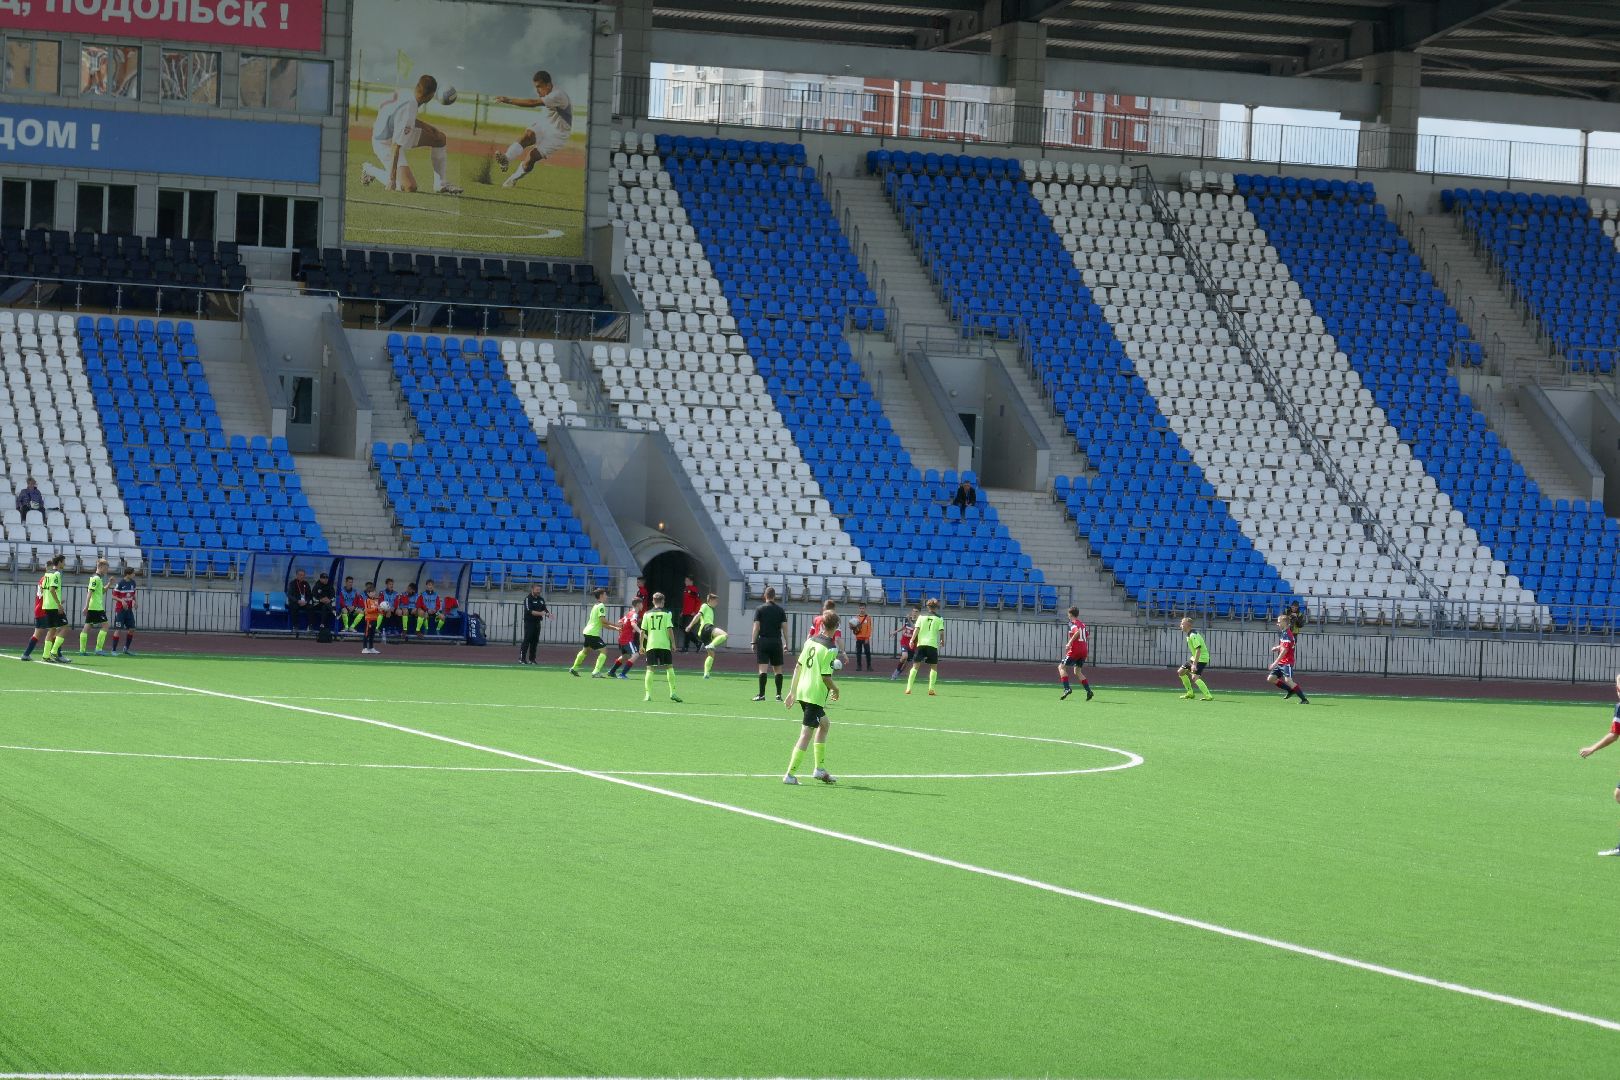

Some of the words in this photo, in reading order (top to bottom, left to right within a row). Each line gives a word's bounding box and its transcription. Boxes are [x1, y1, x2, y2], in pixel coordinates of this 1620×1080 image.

[650, 615, 663, 630] 17
[927, 618, 933, 631] 7
[806, 646, 816, 669] 8
